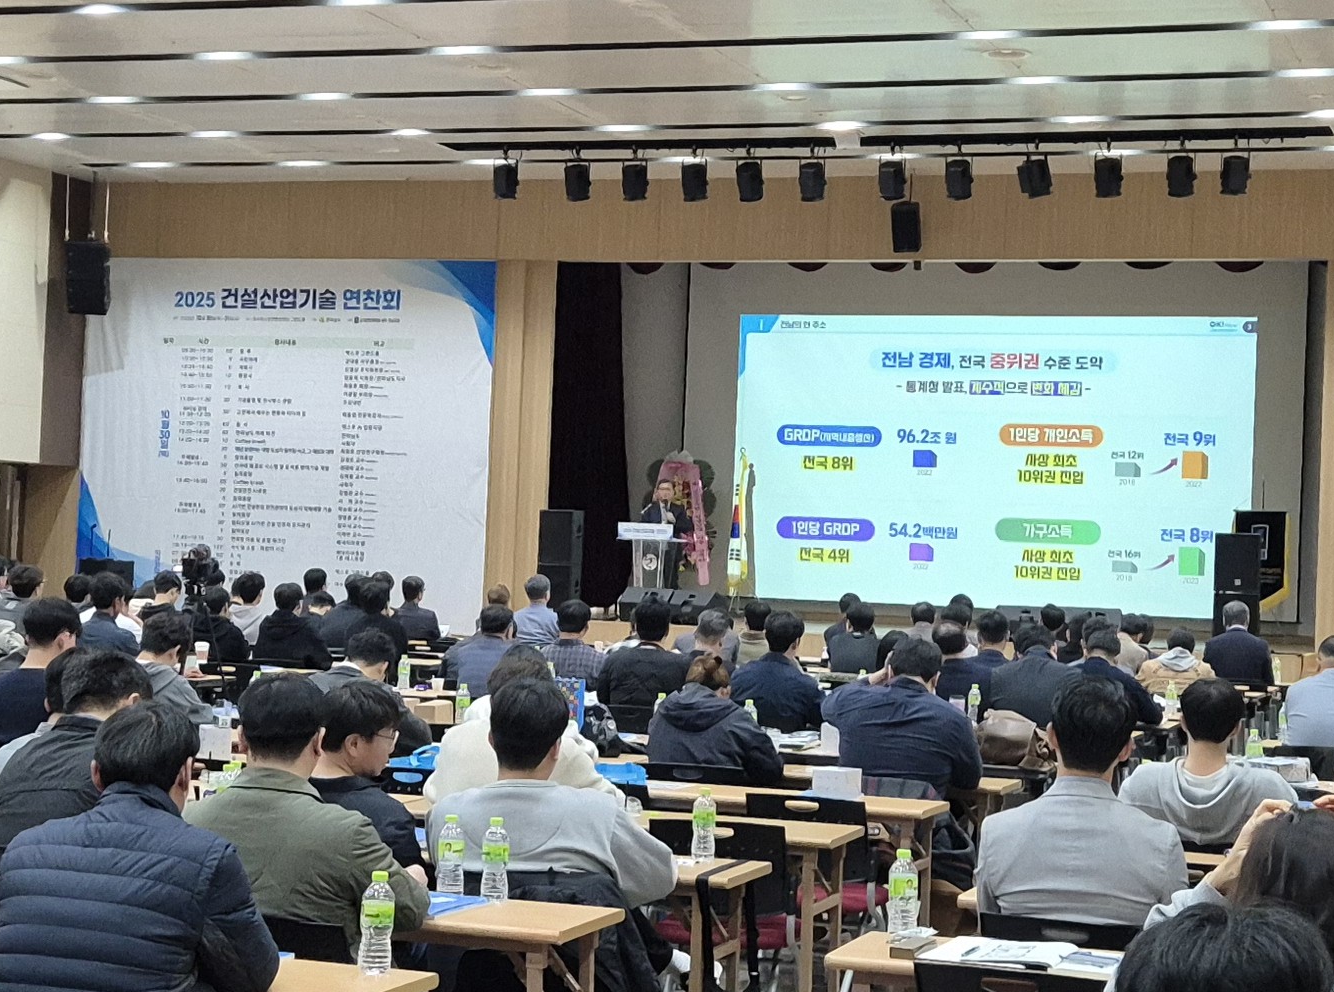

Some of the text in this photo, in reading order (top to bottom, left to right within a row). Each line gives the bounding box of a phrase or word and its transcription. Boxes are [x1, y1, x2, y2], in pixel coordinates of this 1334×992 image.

[174, 287, 401, 311] 2025 건설산업기술 연찬회
[812, 320, 827, 330] 주소
[881, 351, 1103, 370] 전남 경제, 전국 중위권 수준 도약
[897, 428, 957, 445] 96.2조 원
[1009, 427, 1094, 444] 1인당 개인소득
[1163, 431, 1216, 448] 전국 9위
[803, 454, 854, 471] 전국 8위
[1025, 453, 1077, 469] 사상 최초
[1017, 468, 1084, 485] 10위권 진입
[792, 520, 860, 536] 1인당 GRDP
[889, 522, 958, 540] 54.2백만원
[1023, 522, 1073, 539] 가구소득
[1161, 528, 1214, 544] 전국 8위
[799, 546, 850, 563] 전국 4위
[1021, 549, 1074, 564] 사상 최초
[1014, 564, 1081, 582] 10위권 진입
